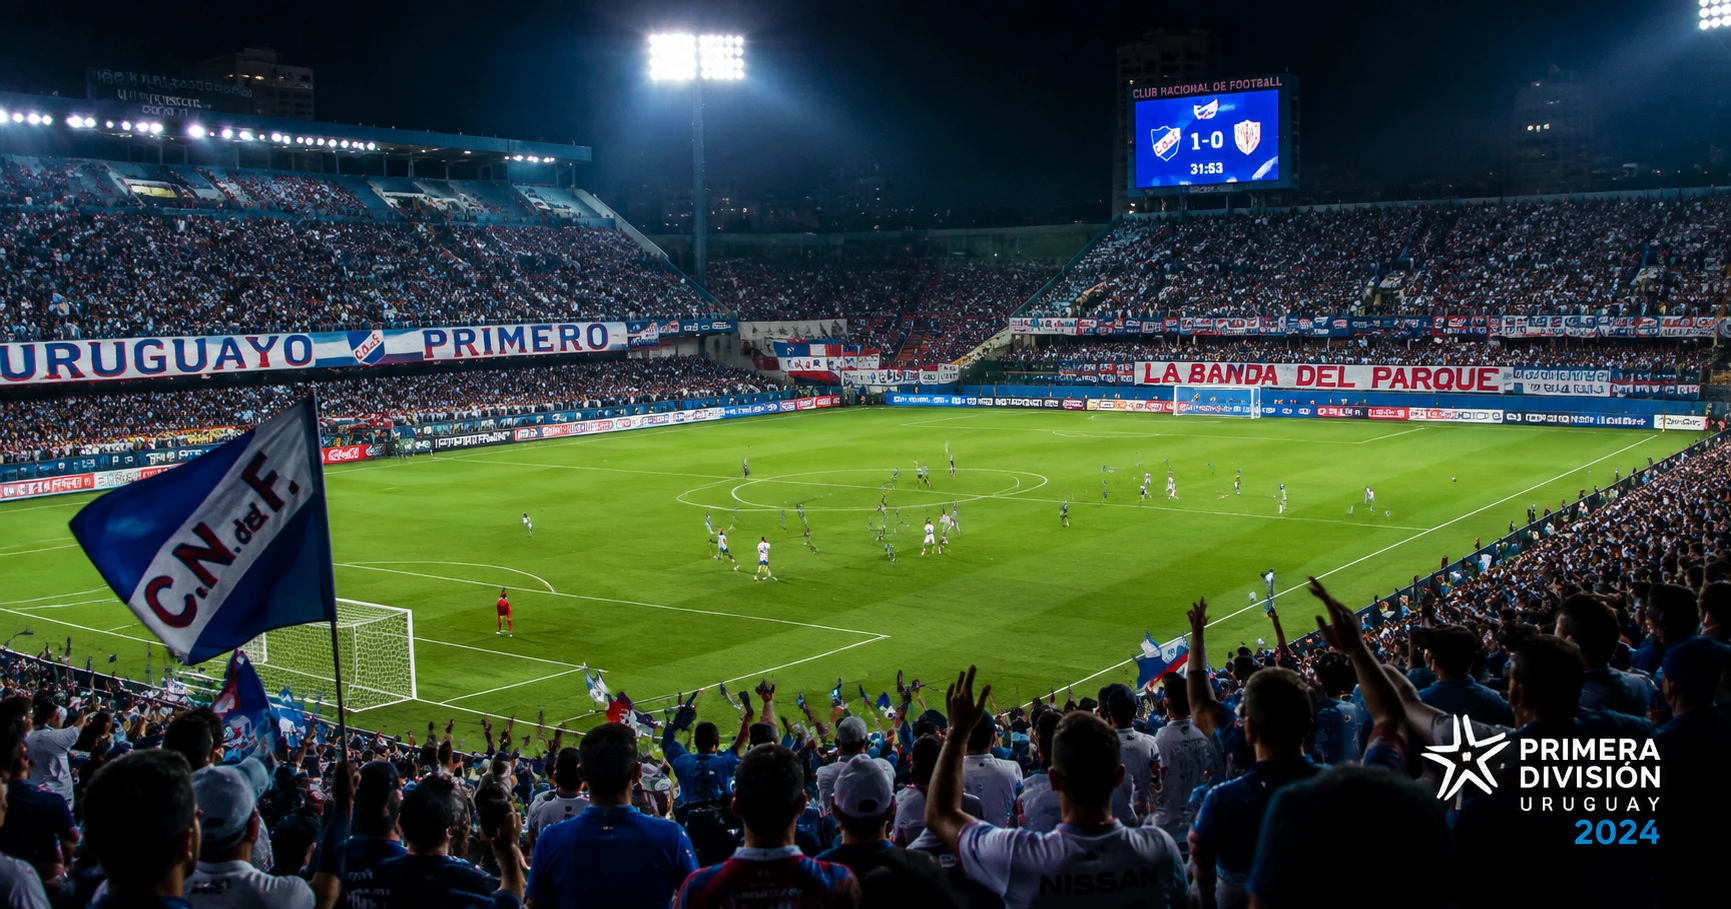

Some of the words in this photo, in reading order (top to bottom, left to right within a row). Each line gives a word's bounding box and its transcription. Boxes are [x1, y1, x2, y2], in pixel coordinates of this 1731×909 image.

[1133, 87, 1157, 98] CLUB
[1213, 81, 1226, 91] DE
[0, 334, 313, 381] URUGUAYO
[422, 323, 609, 358] PRIMERO
[1144, 363, 1182, 384] LA
[1188, 363, 1278, 385] BANDA
[1296, 365, 1355, 387] DEL
[1371, 366, 1500, 391] PARQUE
[1040, 866, 1158, 896] NISSAN
